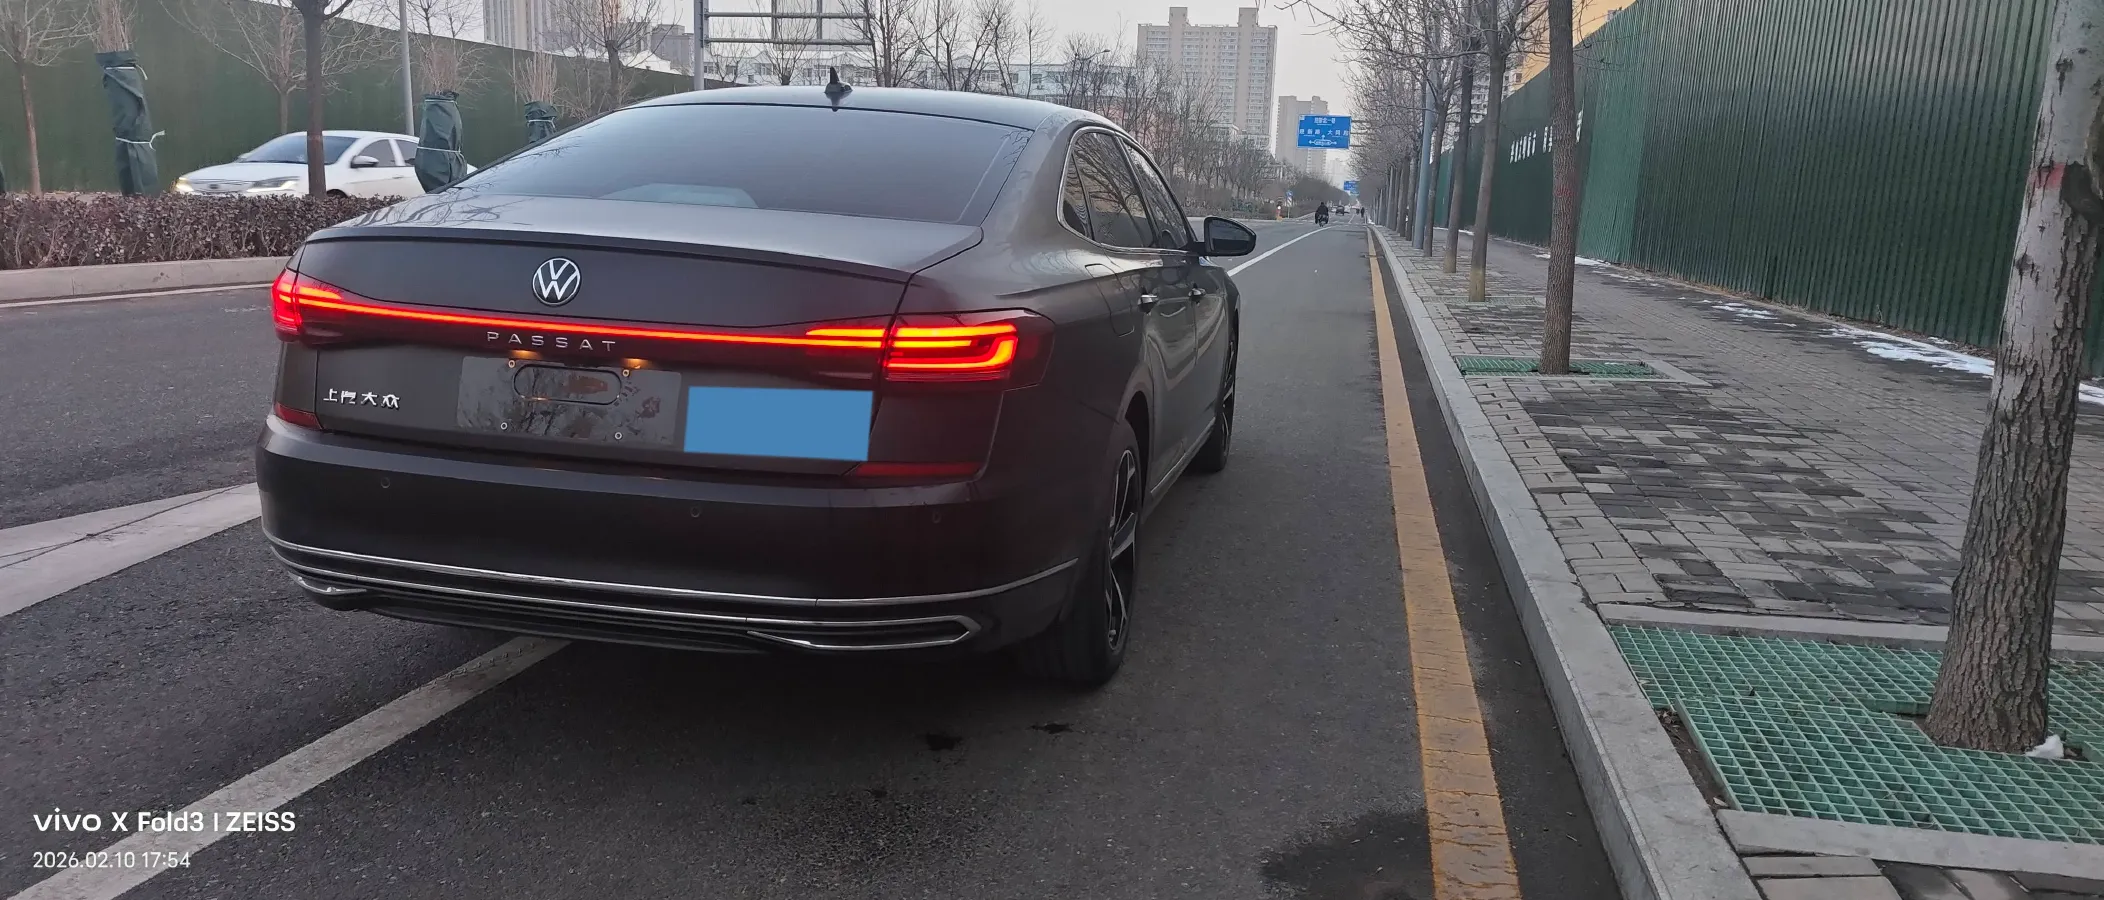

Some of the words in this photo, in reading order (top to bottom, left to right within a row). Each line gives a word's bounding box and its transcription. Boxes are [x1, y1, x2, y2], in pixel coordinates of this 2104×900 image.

[486, 331, 616, 352] PASSAT
[322, 388, 400, 409] 上汽大众
